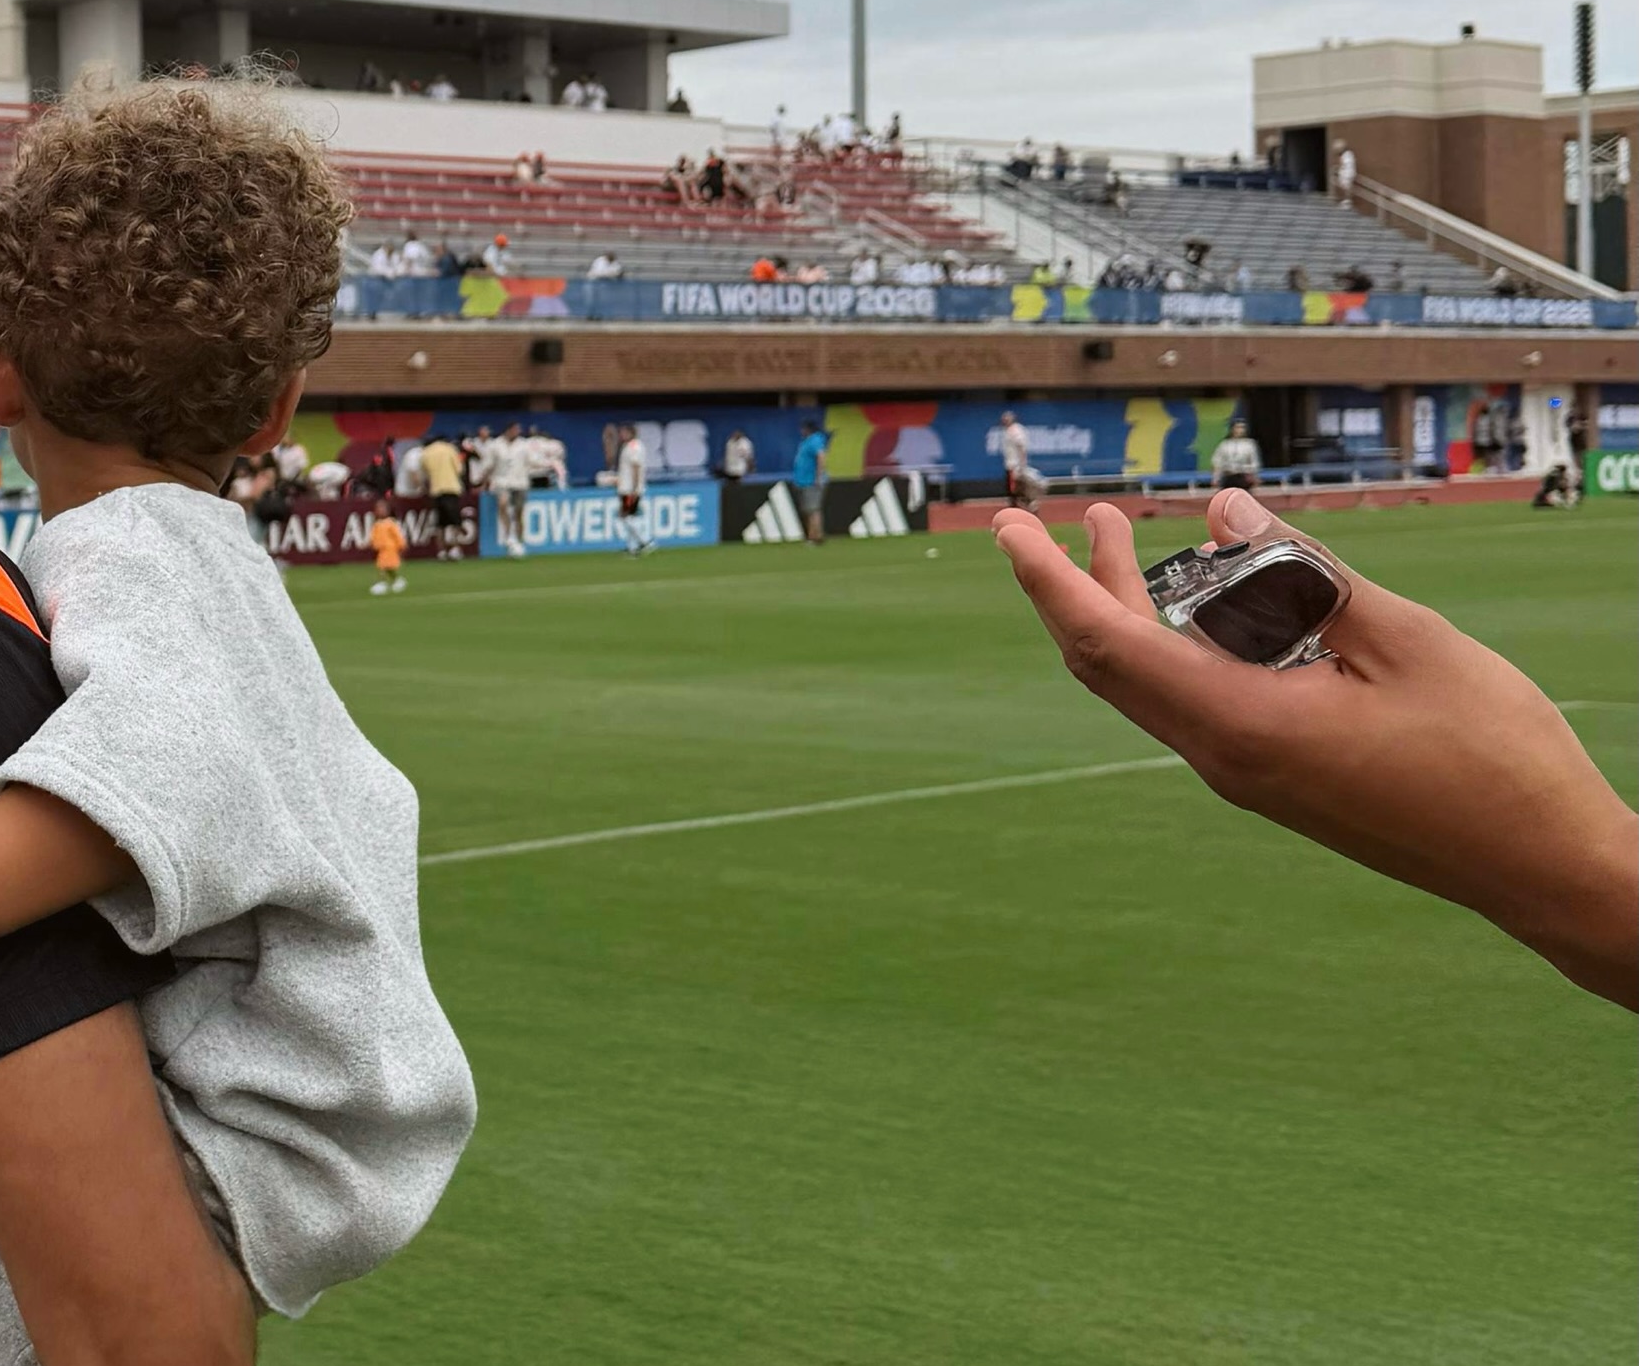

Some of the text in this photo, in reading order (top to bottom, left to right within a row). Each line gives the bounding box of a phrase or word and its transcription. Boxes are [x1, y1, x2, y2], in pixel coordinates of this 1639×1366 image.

[662, 284, 716, 316] FIFA
[717, 285, 806, 316] WORLD
[807, 285, 853, 317] CUP
